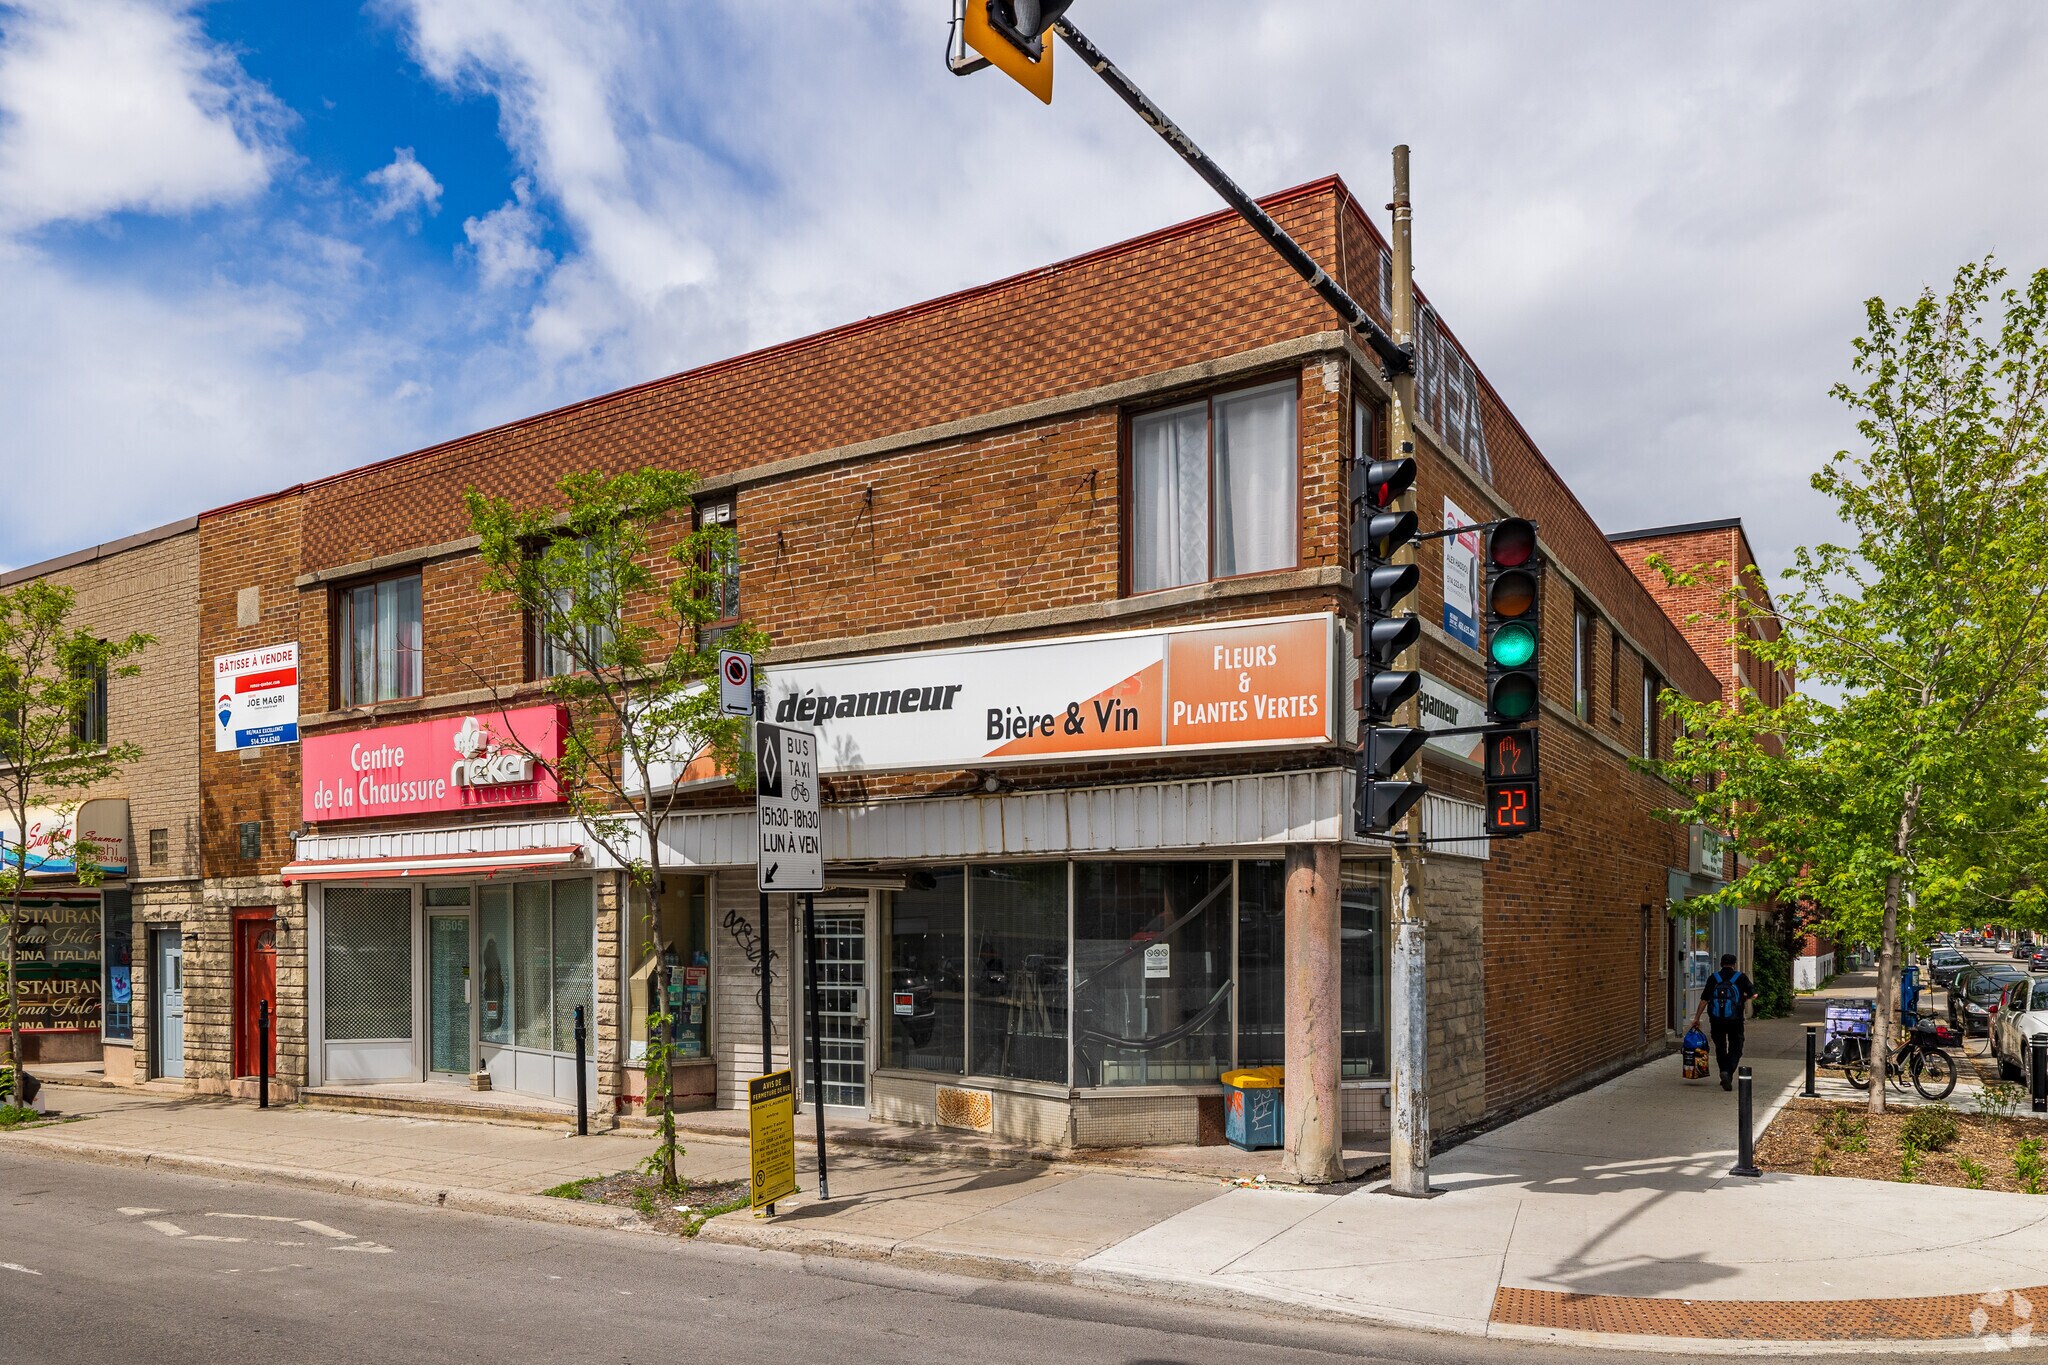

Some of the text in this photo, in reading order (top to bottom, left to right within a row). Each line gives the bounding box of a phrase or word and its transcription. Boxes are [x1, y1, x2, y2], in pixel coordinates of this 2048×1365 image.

[220, 650, 292, 672] BÂTISSE À VENDRE
[1213, 644, 1276, 670] FLEURS
[1238, 672, 1251, 693] &
[247, 698, 260, 708] JOE
[262, 695, 284, 705] MAGRI
[775, 683, 962, 726] dépanneur
[1173, 694, 1318, 726] PLANTES VERTES
[986, 698, 1138, 741] Bière & Vin
[351, 743, 404, 771] Centre
[787, 737, 809, 756] BUS
[788, 759, 810, 778] TAXI
[314, 776, 446, 809] de la Chaussure
[1497, 789, 1527, 826] 22
[763, 831, 819, 854] LUN À VEN
[440, 920, 463, 931] 8505
[763, 1078, 782, 1090] AVIS DE
